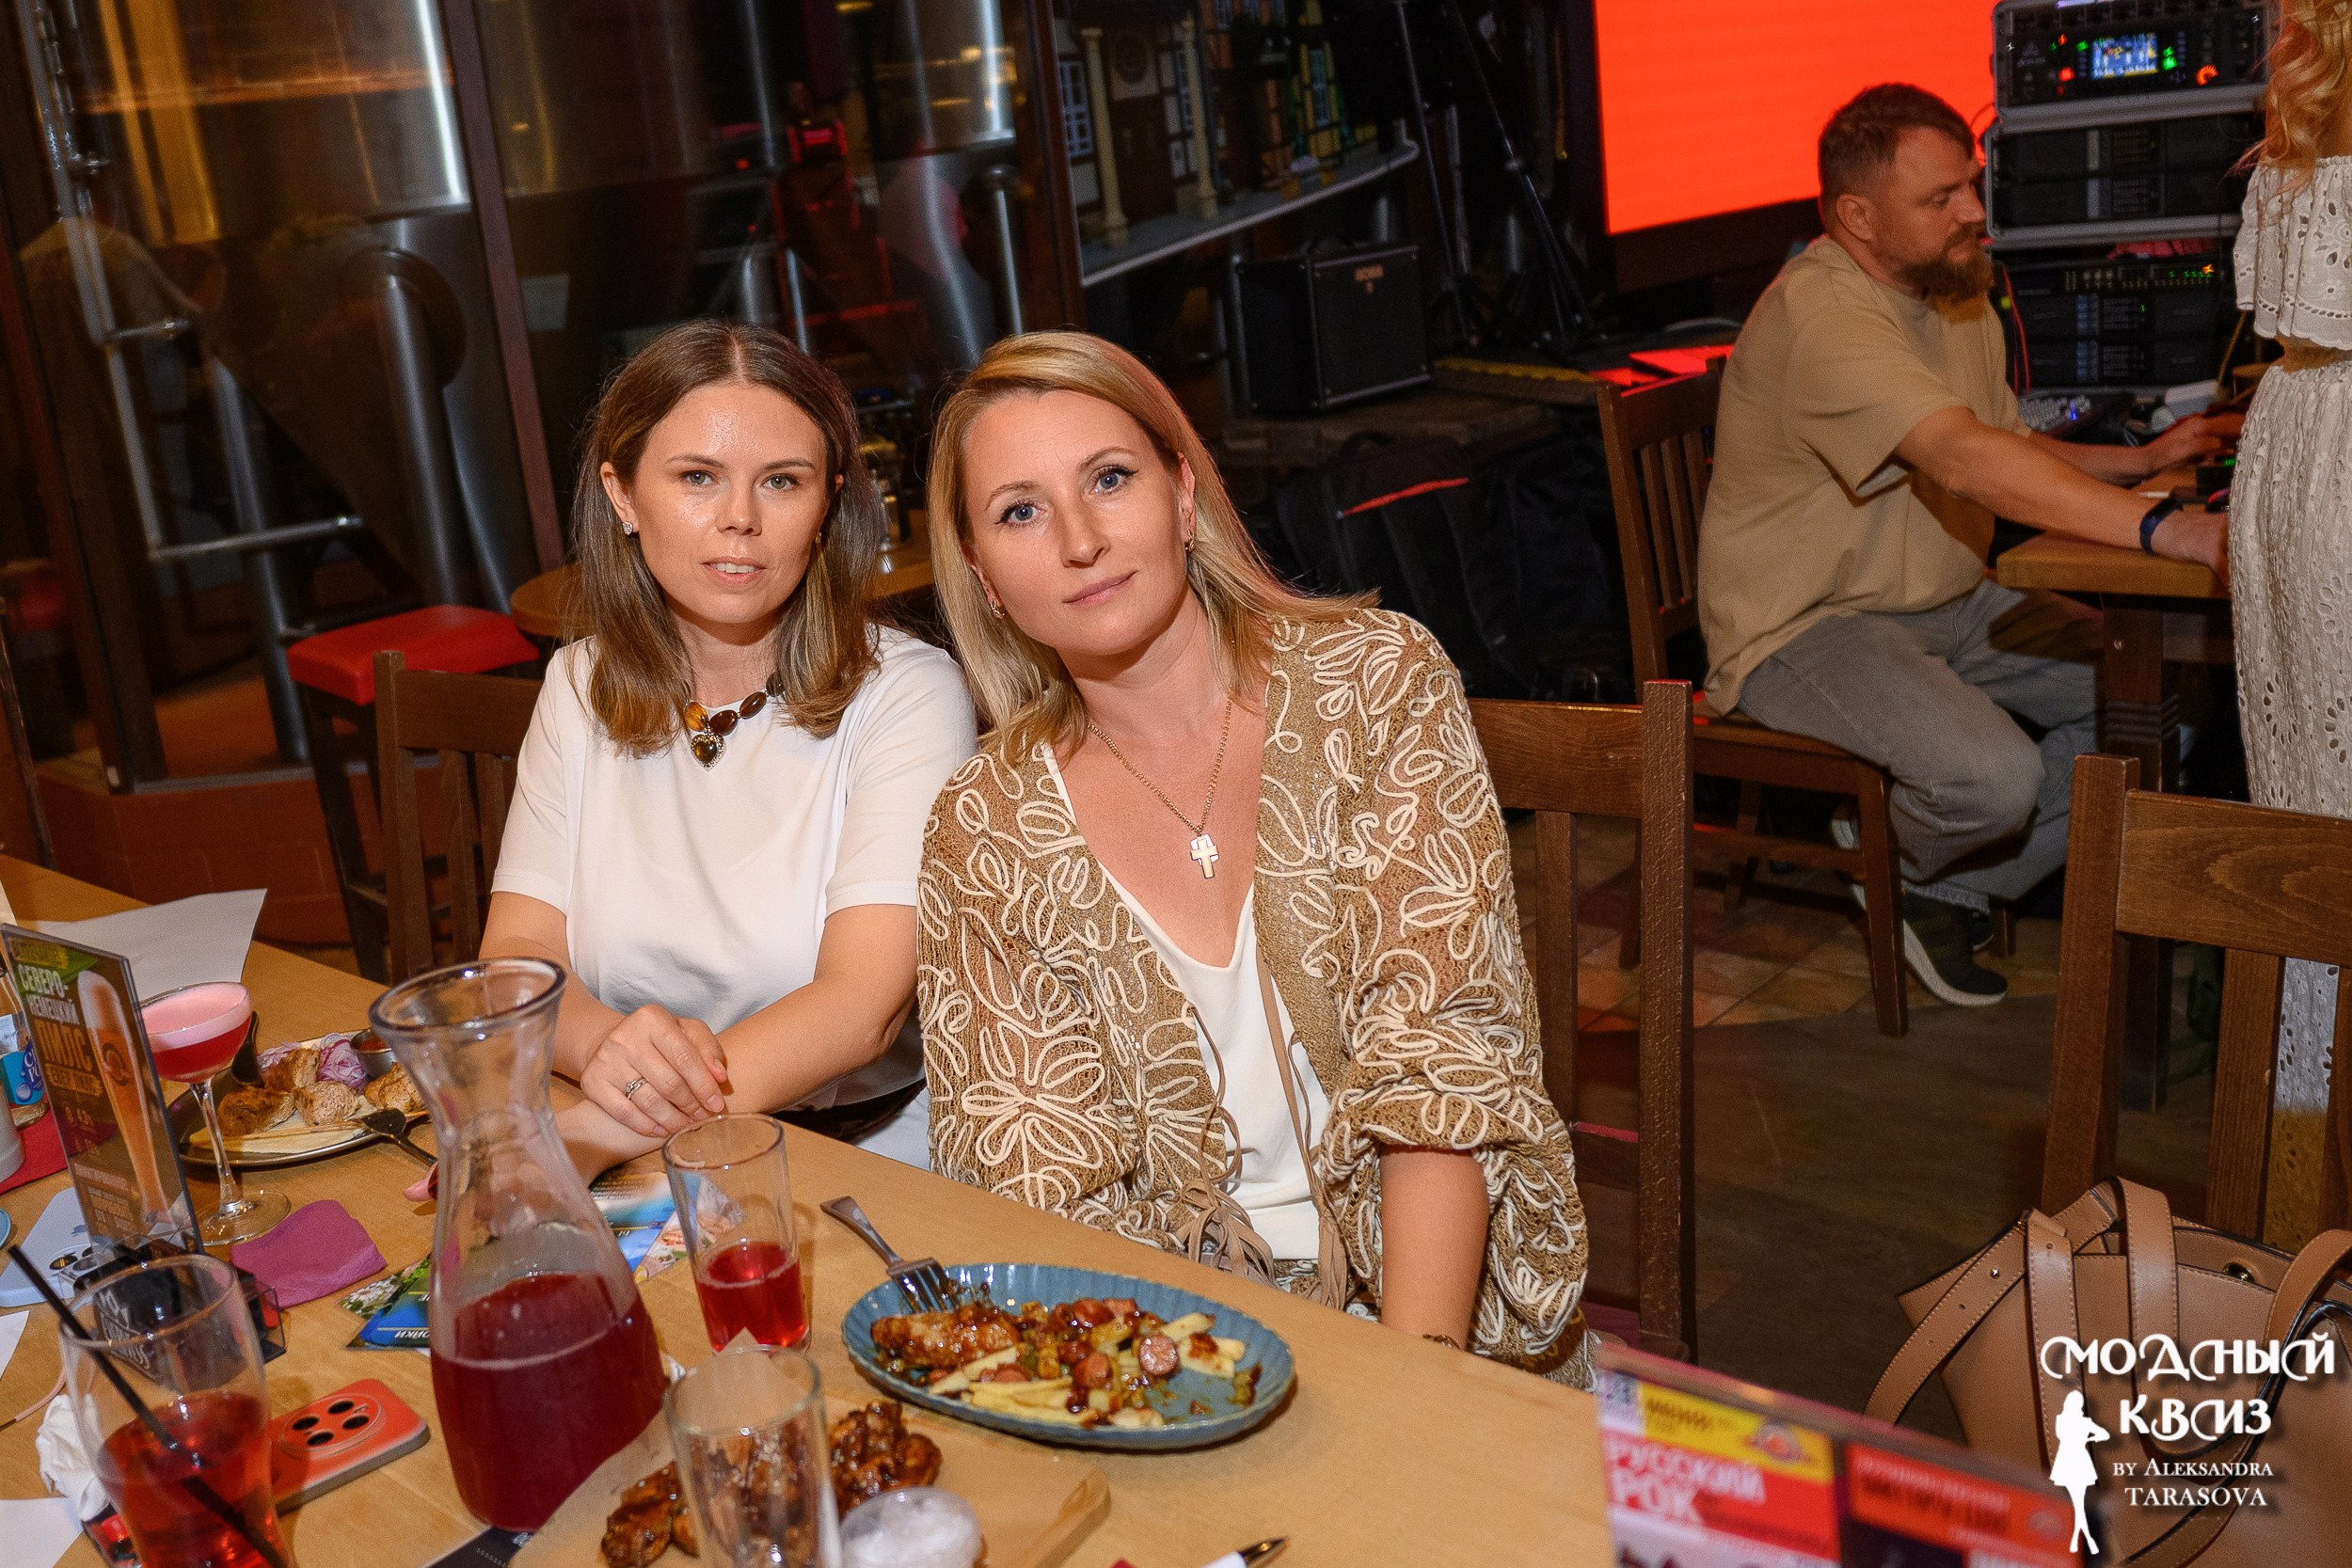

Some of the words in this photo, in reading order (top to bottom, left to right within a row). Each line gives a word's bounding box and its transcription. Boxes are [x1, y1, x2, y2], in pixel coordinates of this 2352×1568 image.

[18, 963, 69, 998] СЕВЕРО-
[1607, 1437, 1766, 1507] РУССКИЙ
[1611, 1468, 1704, 1528] РОК
